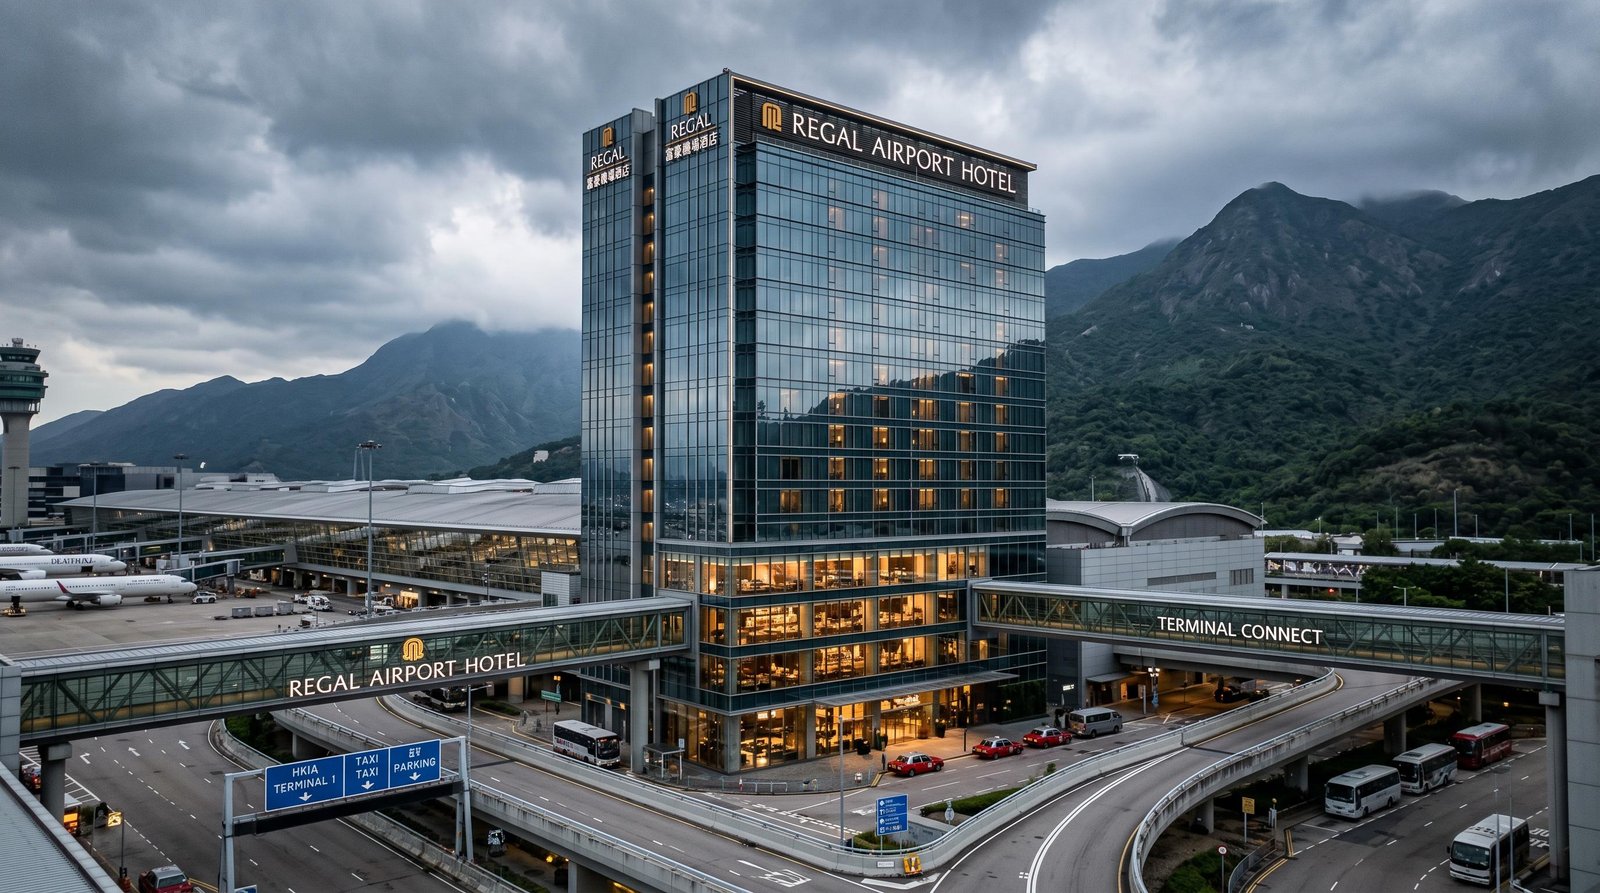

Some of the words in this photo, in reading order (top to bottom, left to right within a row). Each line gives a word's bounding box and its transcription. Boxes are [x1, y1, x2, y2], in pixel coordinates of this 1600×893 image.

[671, 112, 712, 140] REGAL
[591, 146, 625, 171] REGAL
[793, 113, 863, 152] REGAL
[872, 137, 954, 176] AIRPORT
[962, 161, 1017, 194] HOTEL
[1157, 616, 1237, 637] TERMINAL
[1241, 623, 1323, 645] CONNECT
[289, 673, 361, 698] REGAL
[369, 660, 457, 687] AIRPORT
[465, 652, 526, 674] HOTEL
[292, 764, 319, 778] HKIA
[355, 754, 379, 766] TAXI
[393, 757, 436, 773] PARKING
[273, 776, 328, 794] TERMINAL
[332, 774, 336, 784] 1
[355, 767, 379, 779] TAXI
